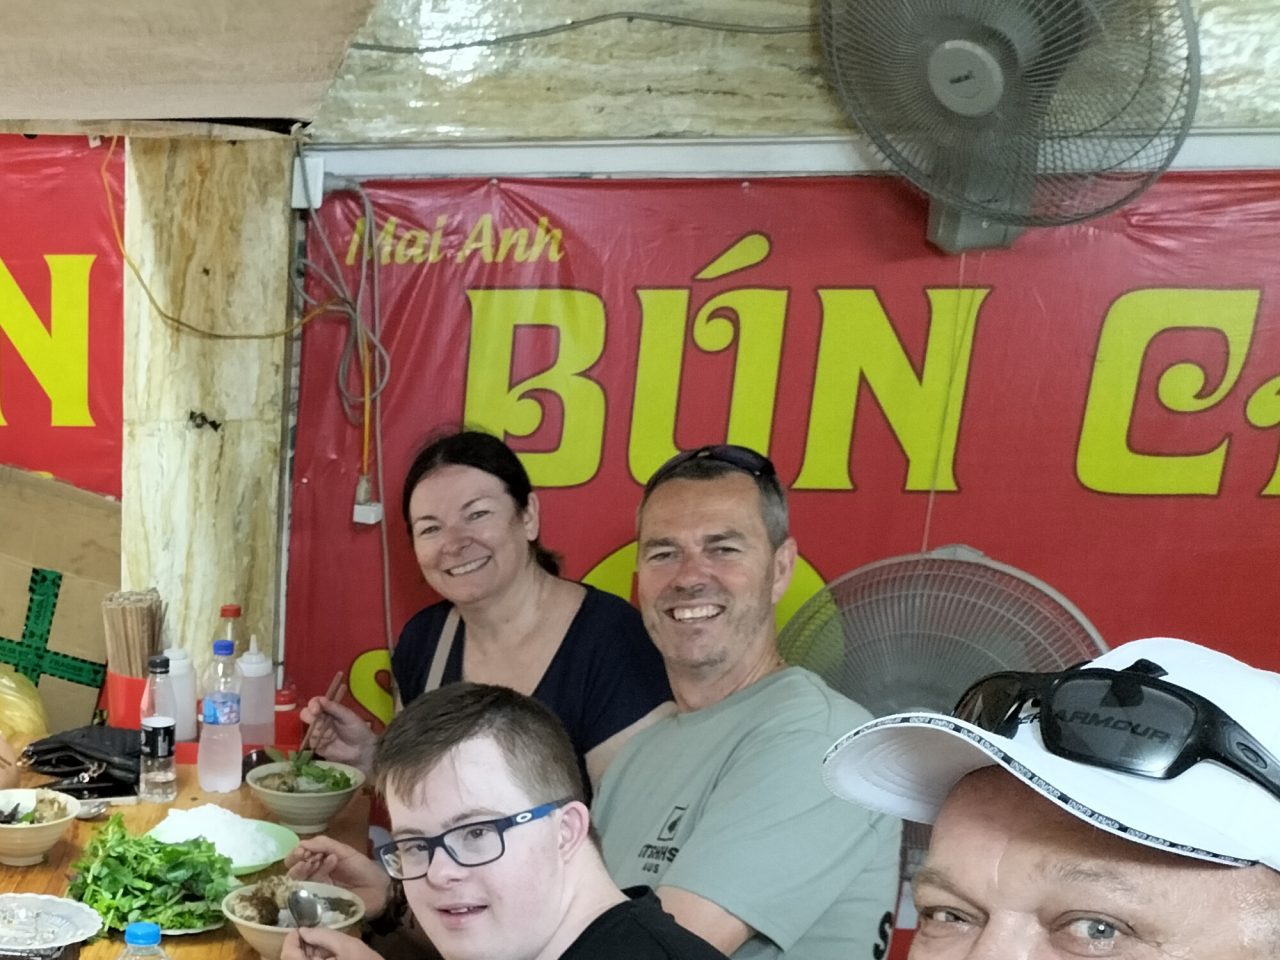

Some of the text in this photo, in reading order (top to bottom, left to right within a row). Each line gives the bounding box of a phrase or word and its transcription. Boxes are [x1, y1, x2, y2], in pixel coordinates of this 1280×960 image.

[345, 212, 565, 266] Mai Anh
[463, 233, 992, 493] BÚN
